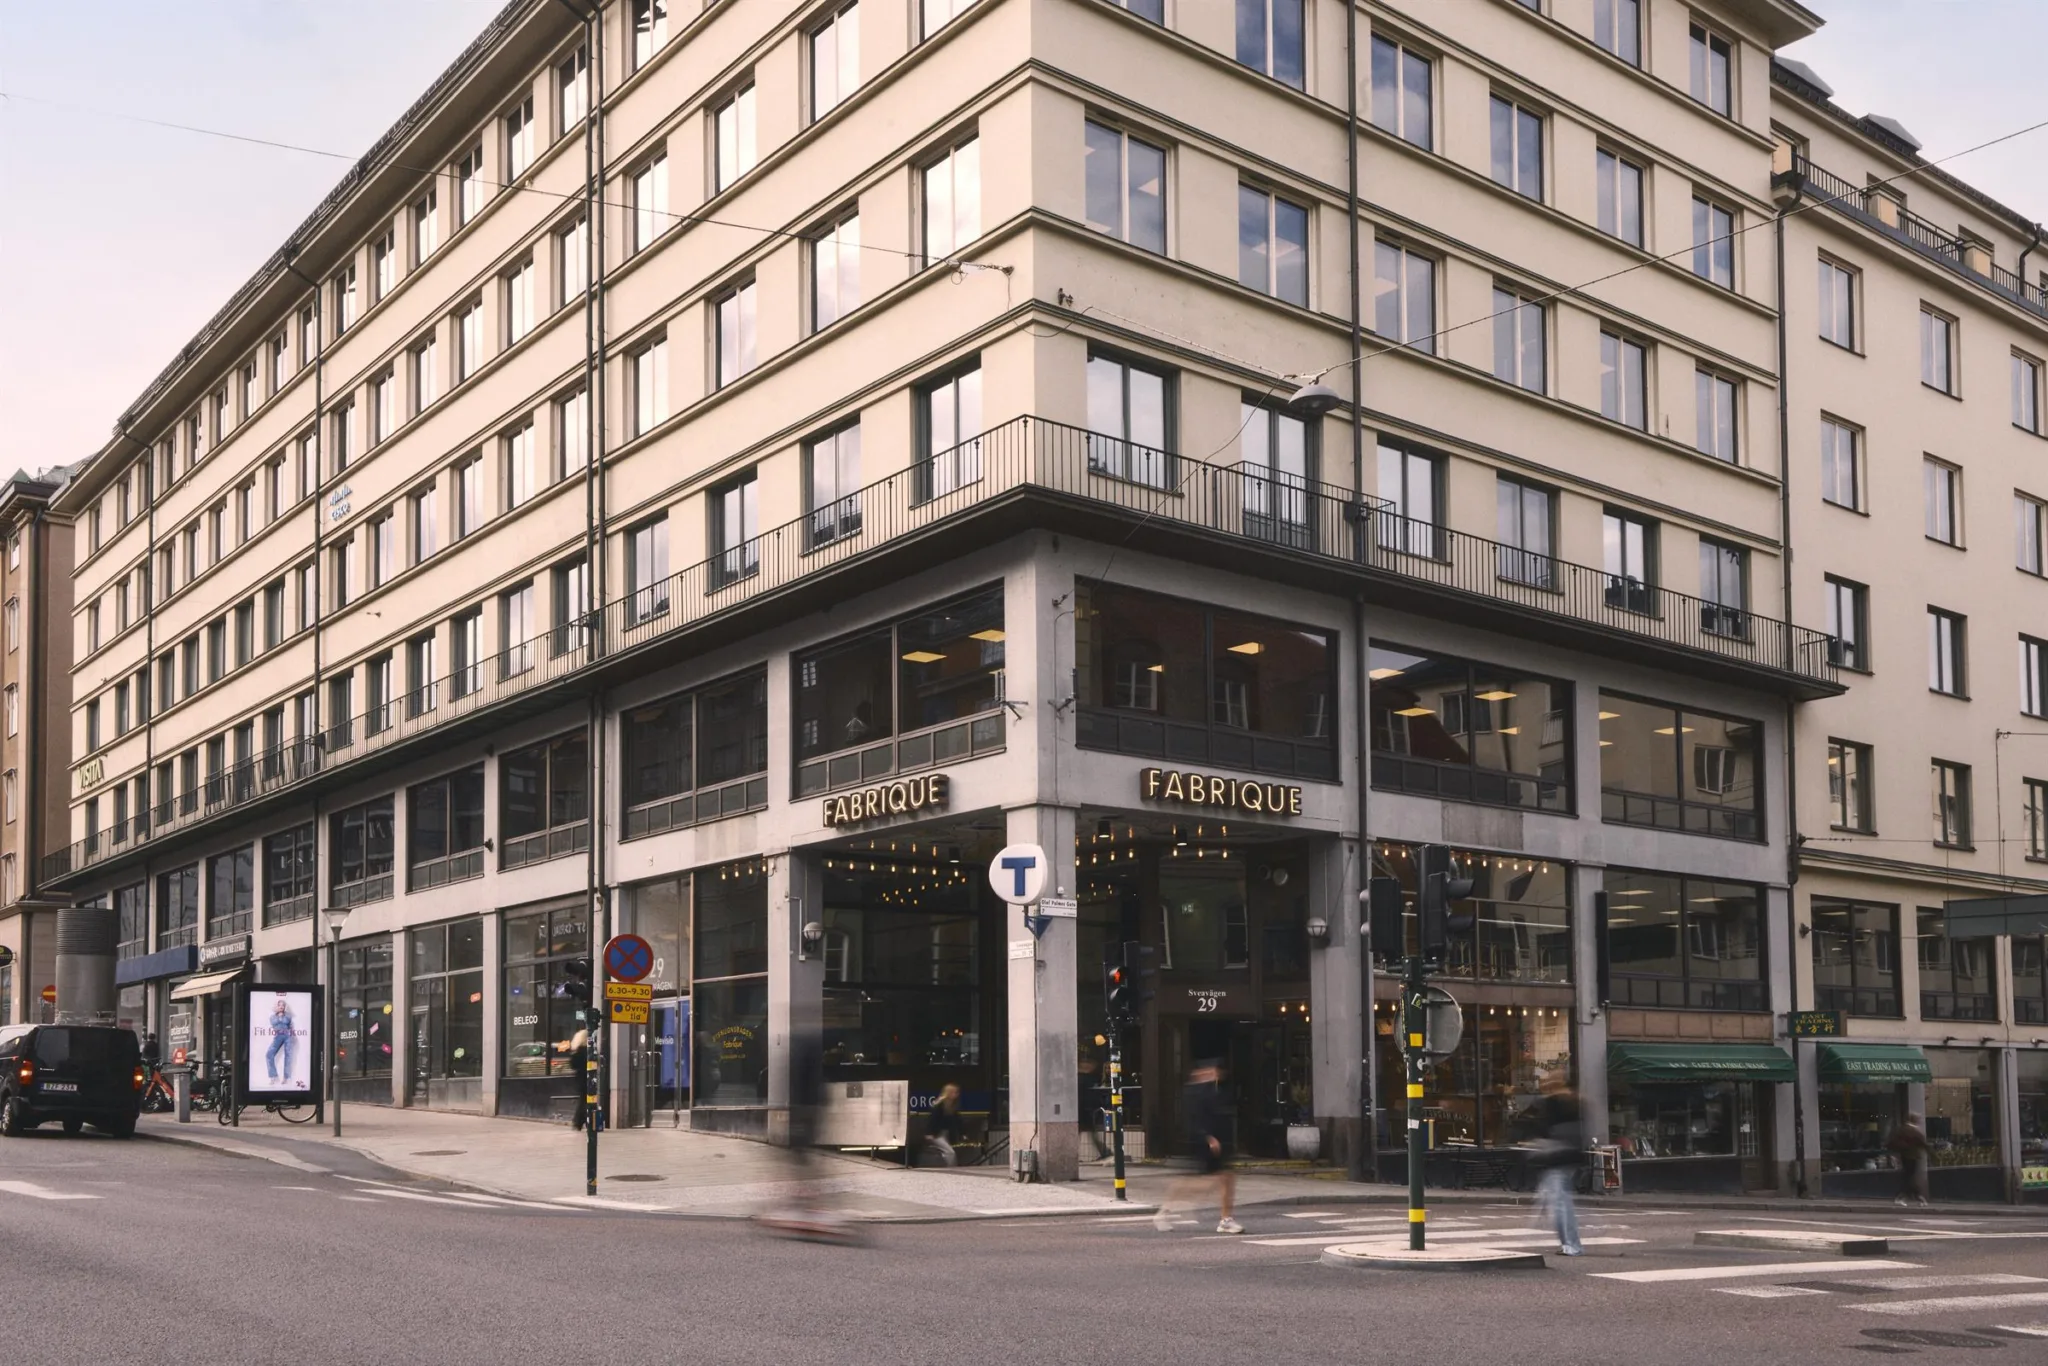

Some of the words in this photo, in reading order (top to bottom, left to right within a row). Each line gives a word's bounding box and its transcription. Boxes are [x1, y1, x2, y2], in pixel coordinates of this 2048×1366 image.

[1144, 769, 1301, 814] FABRIQUE
[823, 775, 945, 827] FABRIQUE
[1001, 856, 1036, 897] T
[608, 986, 650, 996] 6.30-9.30
[1188, 989, 1227, 998] Sveavägen
[624, 1003, 647, 1014] Övrig
[1197, 997, 1217, 1012] 29
[513, 1015, 538, 1026] BELECO
[254, 1027, 266, 1036] Fit
[340, 1030, 358, 1040] BELECO
[1845, 1061, 1862, 1071] EAST
